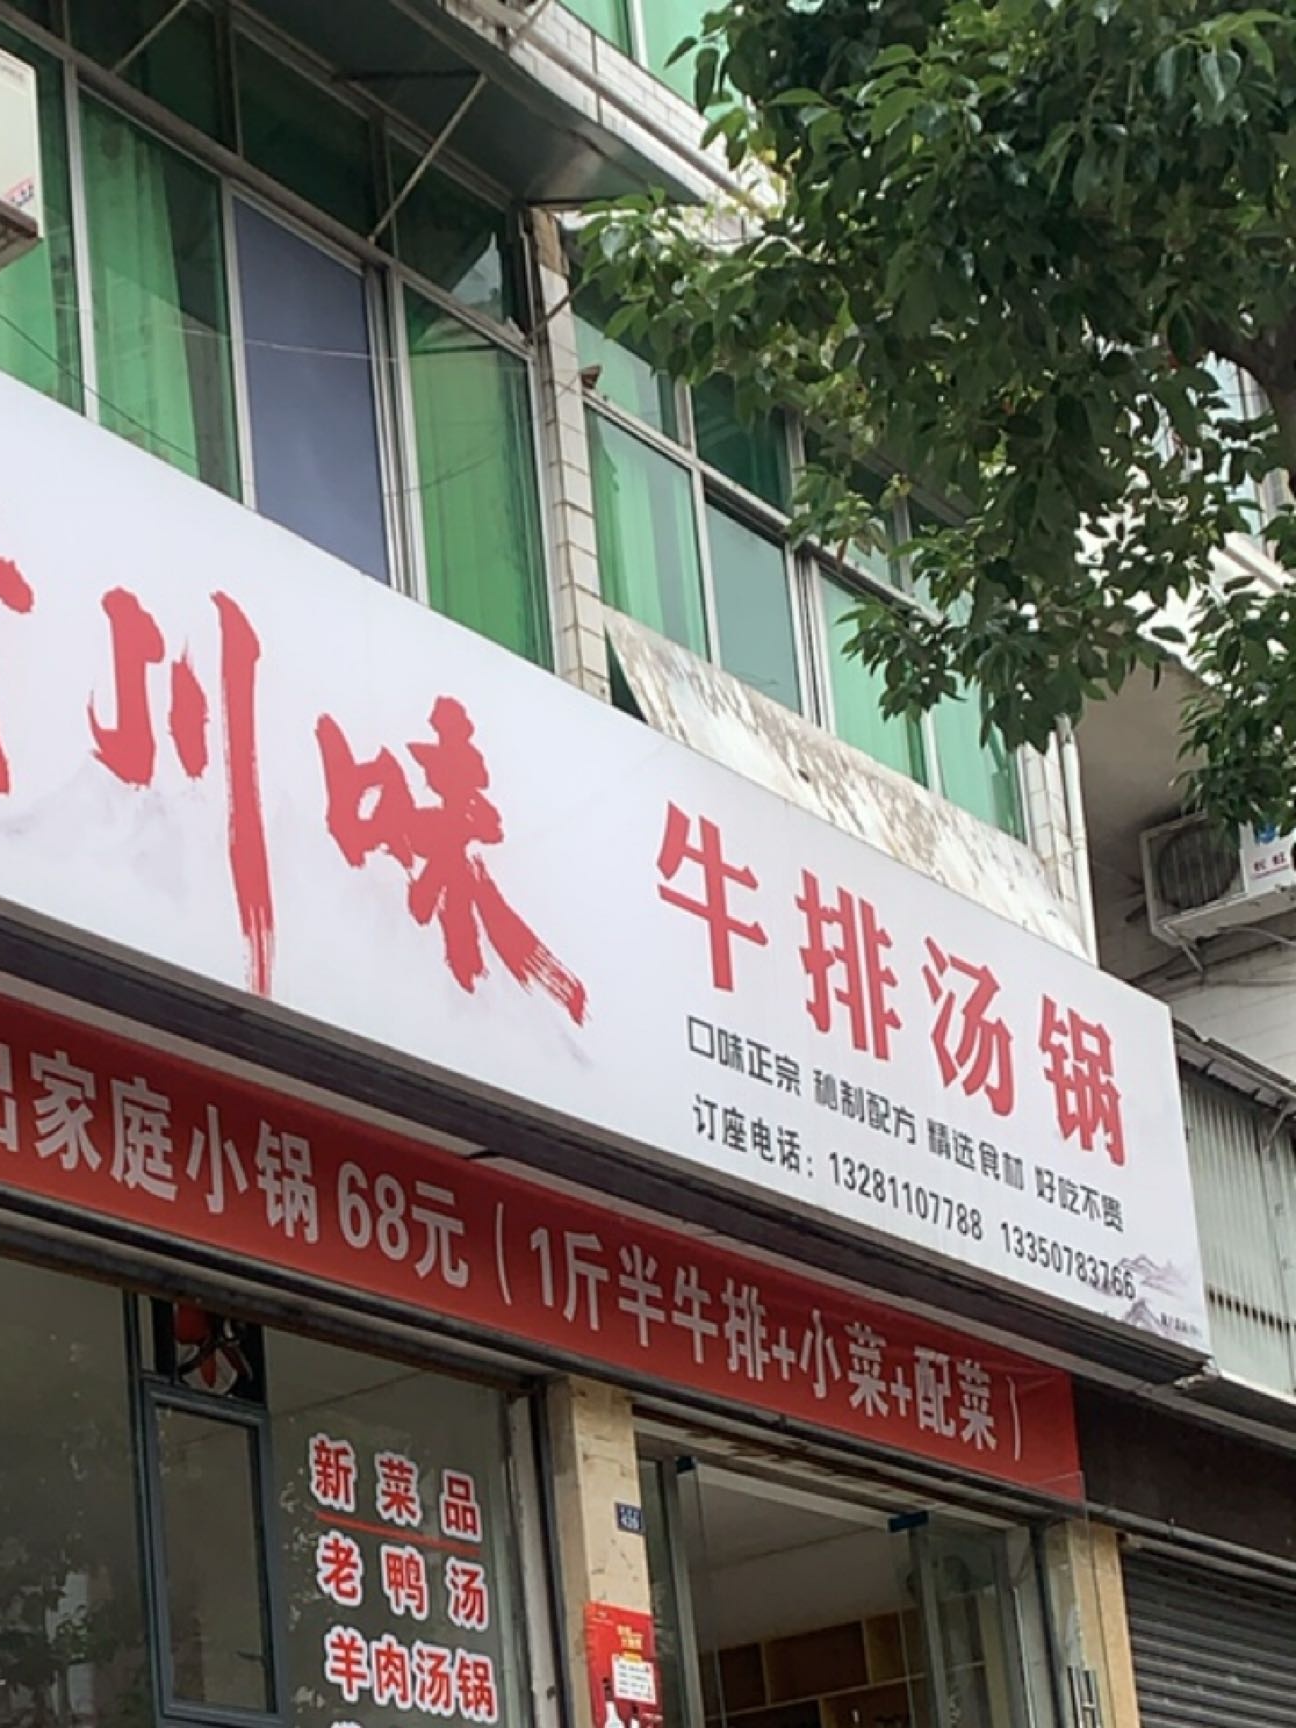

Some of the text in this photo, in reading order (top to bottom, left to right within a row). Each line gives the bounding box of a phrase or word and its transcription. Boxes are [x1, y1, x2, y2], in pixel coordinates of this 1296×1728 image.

[657, 800, 1125, 1167] 牛排汤锅
[687, 1015, 1123, 1232] 口味正宗 秘制配方 精选食材 好吃不贵
[1001, 1222, 1136, 1299] 13350783766
[310, 1434, 481, 1541] 新菜品
[317, 1531, 489, 1630] 老鸭汤
[325, 1625, 498, 1722] 羊肉汤锅
